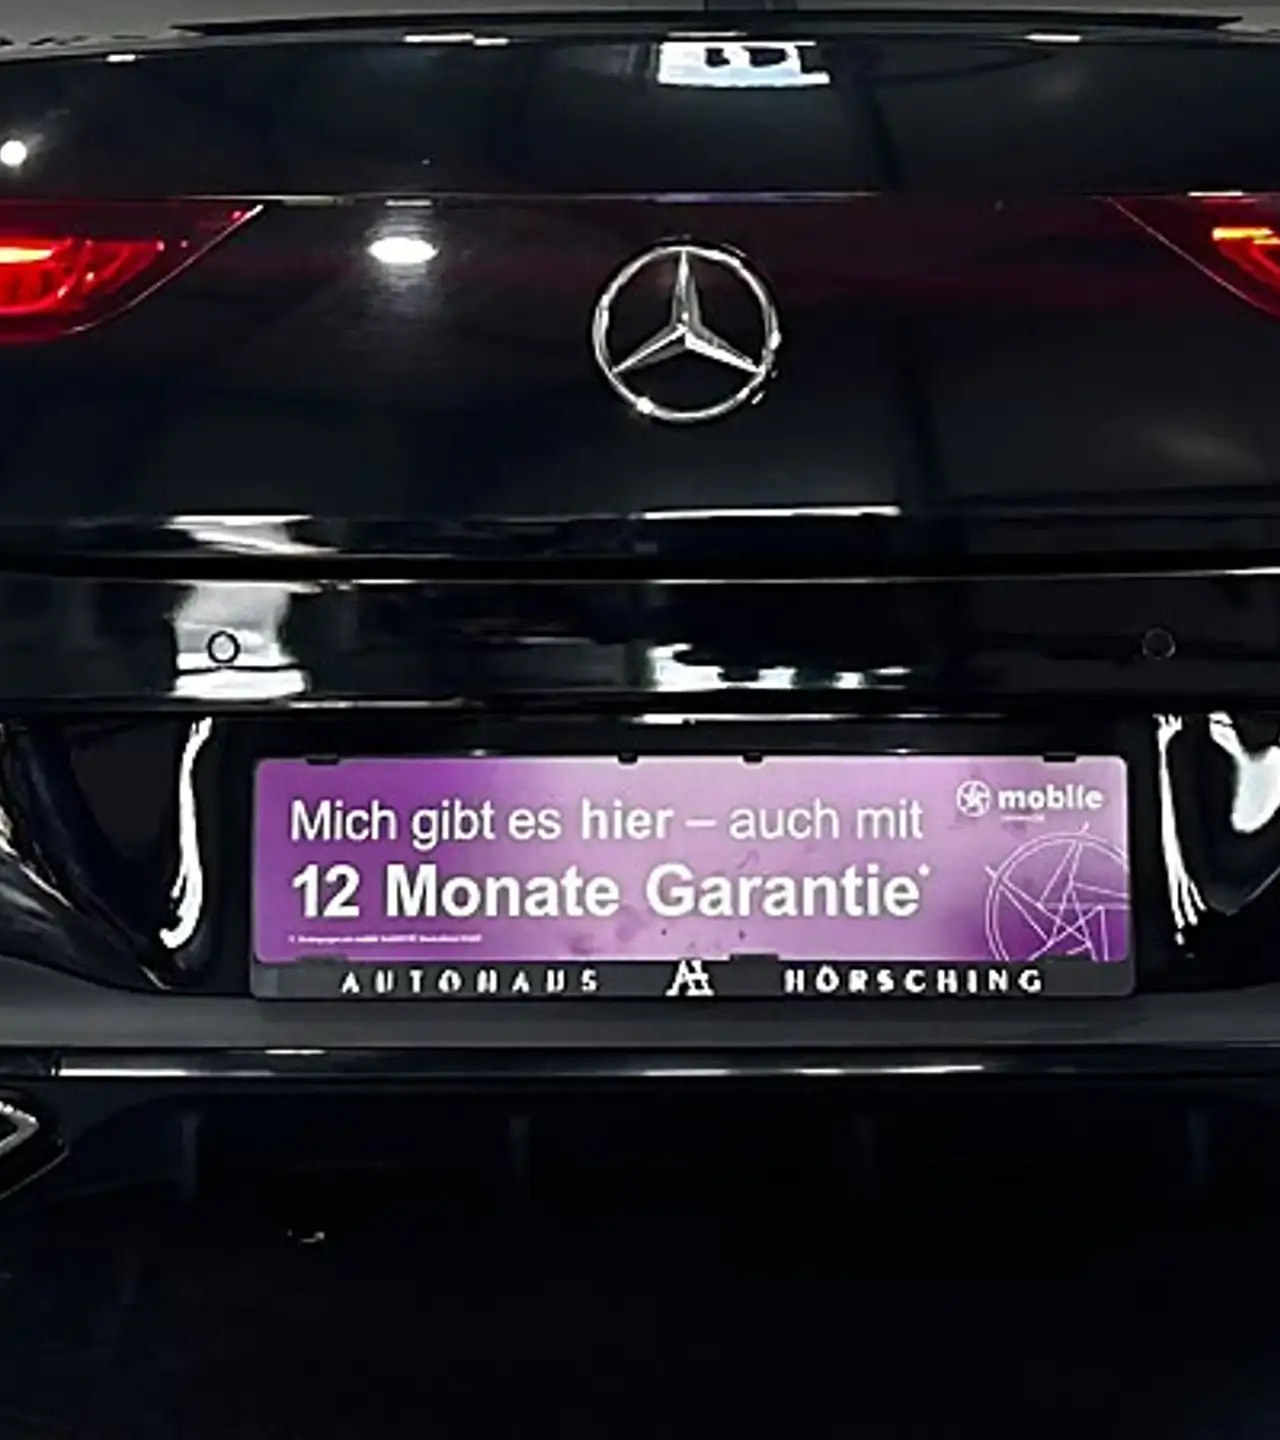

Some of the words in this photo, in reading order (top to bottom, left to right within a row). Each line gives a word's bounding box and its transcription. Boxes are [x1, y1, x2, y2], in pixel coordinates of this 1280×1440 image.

[997, 783, 1104, 810] mobile
[291, 799, 397, 841] Mich
[411, 799, 496, 851] gibt
[508, 807, 563, 841] es
[581, 797, 675, 840] hier
[728, 797, 840, 841] auch
[856, 797, 924, 840] mit
[292, 863, 360, 918] 12
[386, 863, 621, 918] Monate
[340, 968, 598, 995] AUTOHAUS
[783, 965, 1043, 994] HÖRSCHING
